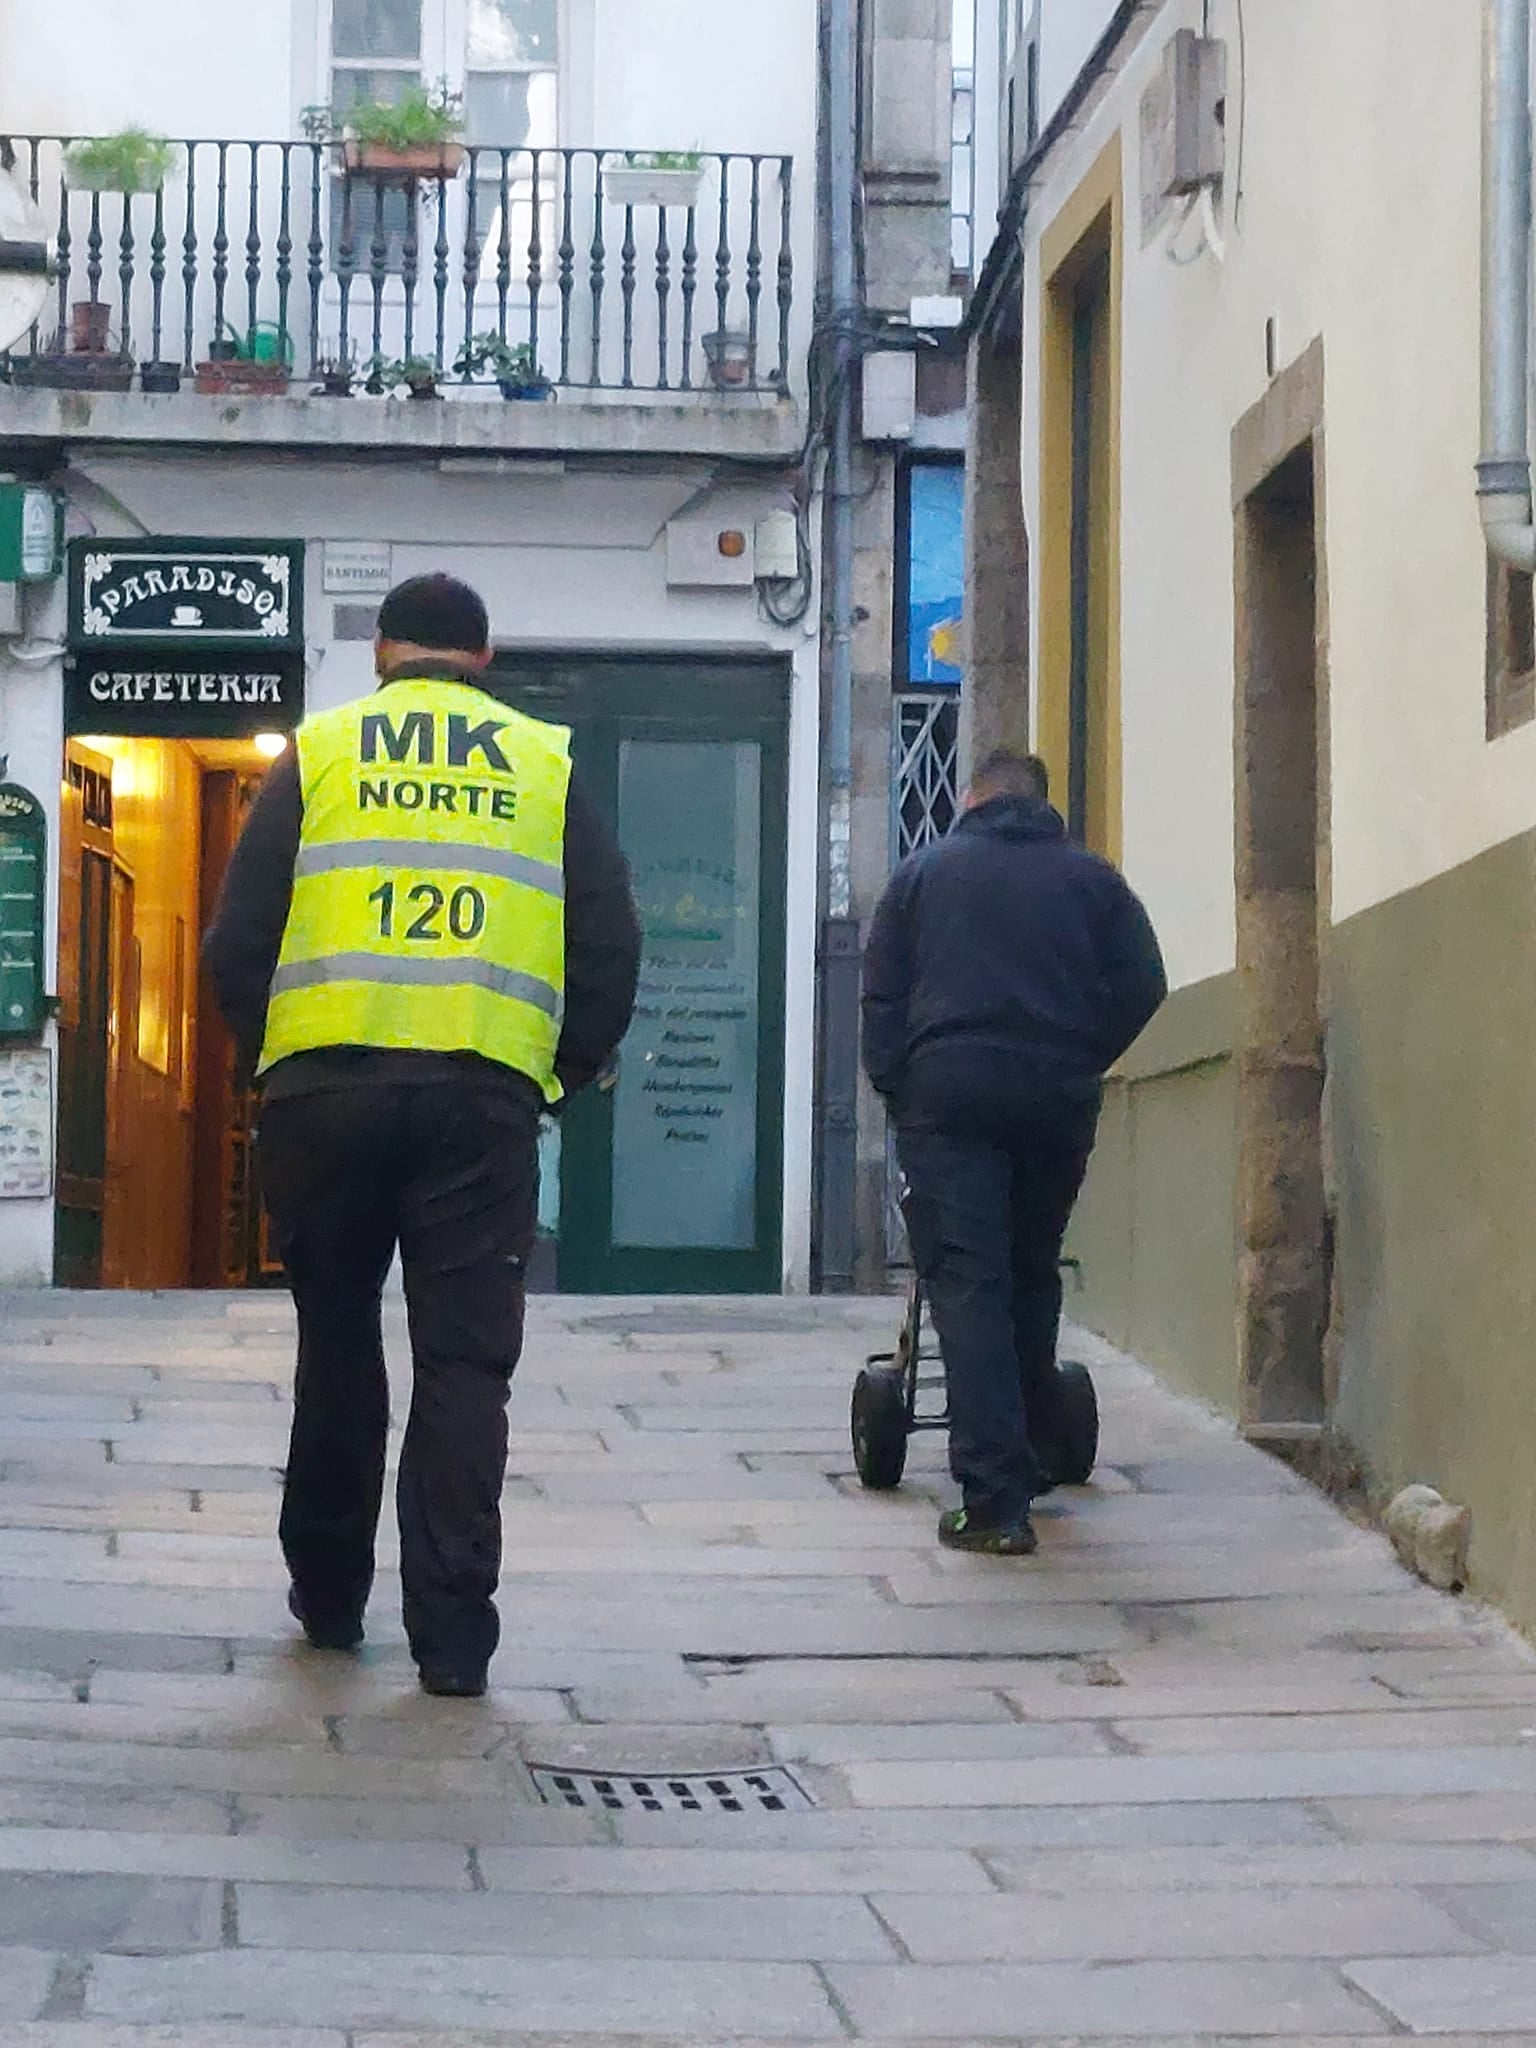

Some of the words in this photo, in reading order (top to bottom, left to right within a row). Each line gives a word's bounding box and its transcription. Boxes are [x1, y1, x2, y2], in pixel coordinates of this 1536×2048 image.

[101, 566, 275, 616] PARADISO
[90, 671, 282, 702] CAFETERIA
[360, 712, 514, 773] MK
[359, 781, 517, 820] NORTE
[368, 882, 485, 940] 120
